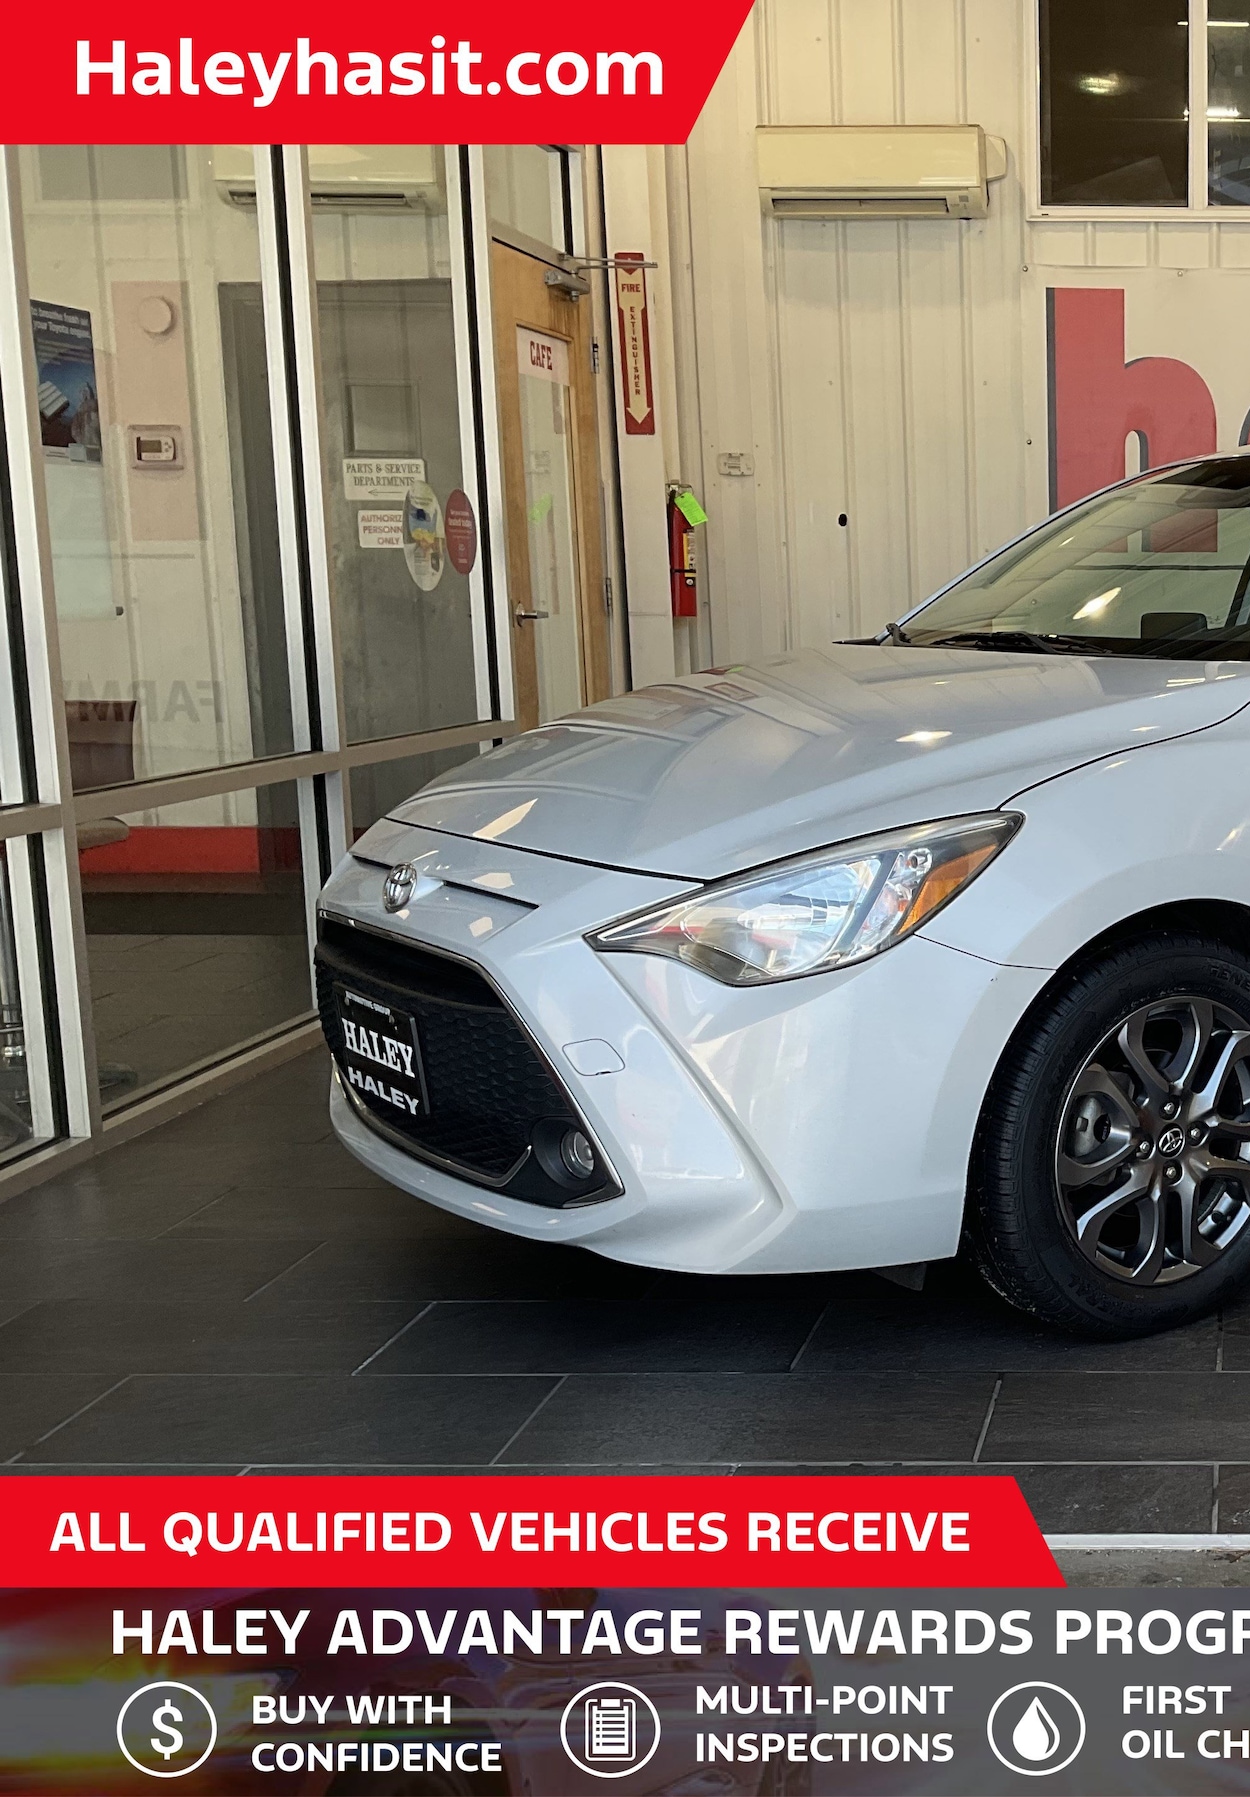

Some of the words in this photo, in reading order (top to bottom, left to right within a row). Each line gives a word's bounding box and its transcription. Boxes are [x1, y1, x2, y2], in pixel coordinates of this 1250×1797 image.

[621, 283, 641, 293] FIRE
[529, 340, 553, 371] CAFE
[629, 306, 641, 396] EXTINGUISHER
[346, 463, 373, 474] PARTS
[375, 463, 383, 474] &
[384, 463, 422, 474] SERVICE
[353, 476, 416, 487] DEPARTMENTS
[360, 513, 403, 523] AUTHORIZ
[362, 525, 403, 534] PERSONN
[377, 536, 401, 545] ONLY
[341, 1017, 416, 1078] HALEY
[347, 1065, 419, 1116] HALEY
